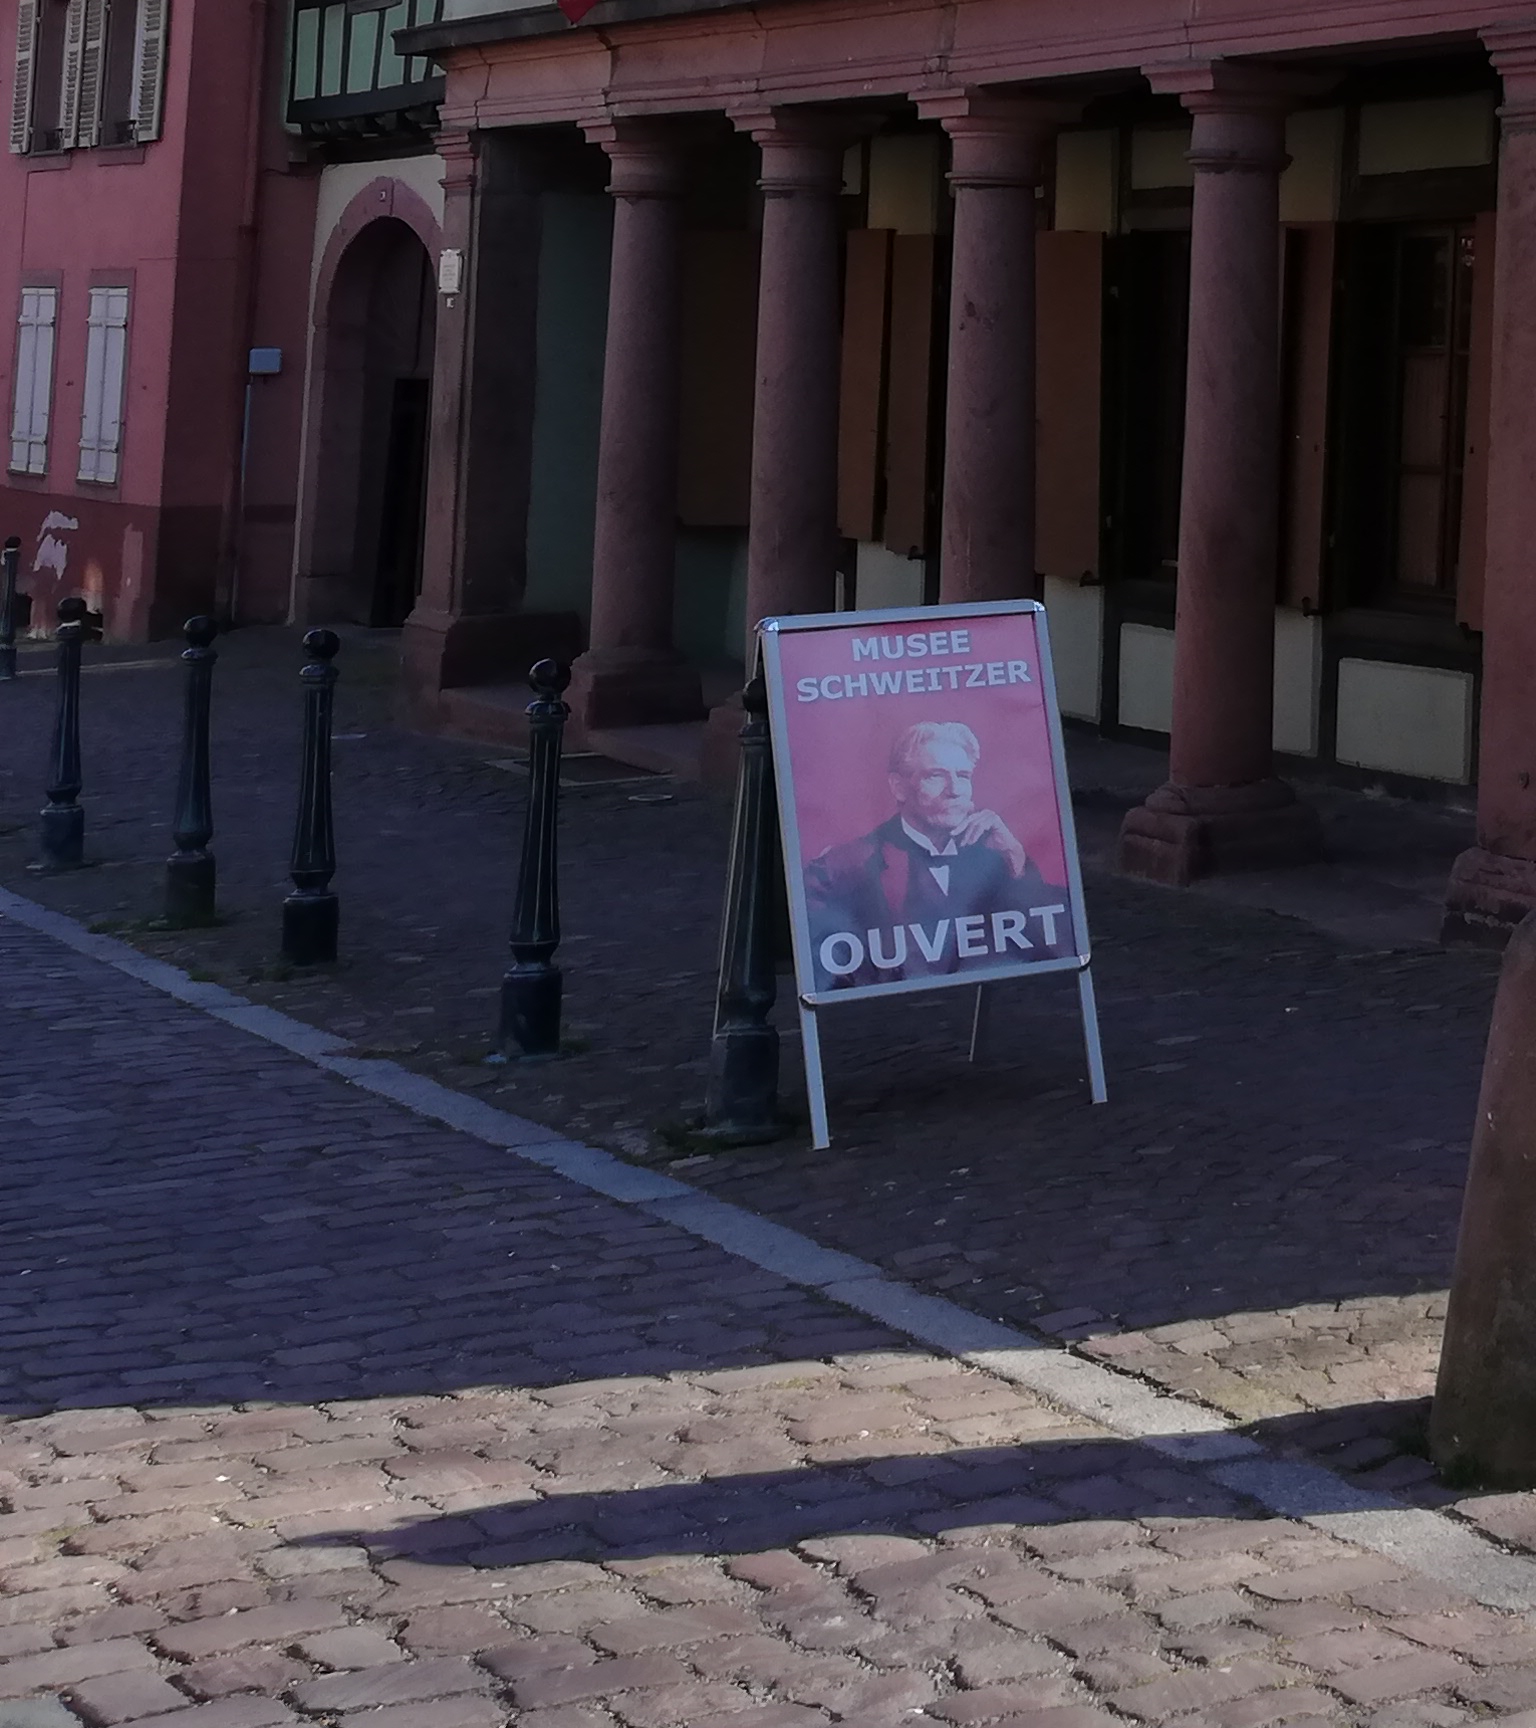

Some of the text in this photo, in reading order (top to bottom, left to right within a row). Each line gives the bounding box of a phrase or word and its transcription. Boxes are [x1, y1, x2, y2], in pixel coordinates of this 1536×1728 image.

[851, 629, 972, 663] MUSEE
[796, 659, 1032, 703] SCHWEITZER
[819, 903, 1066, 976] OUVERT
